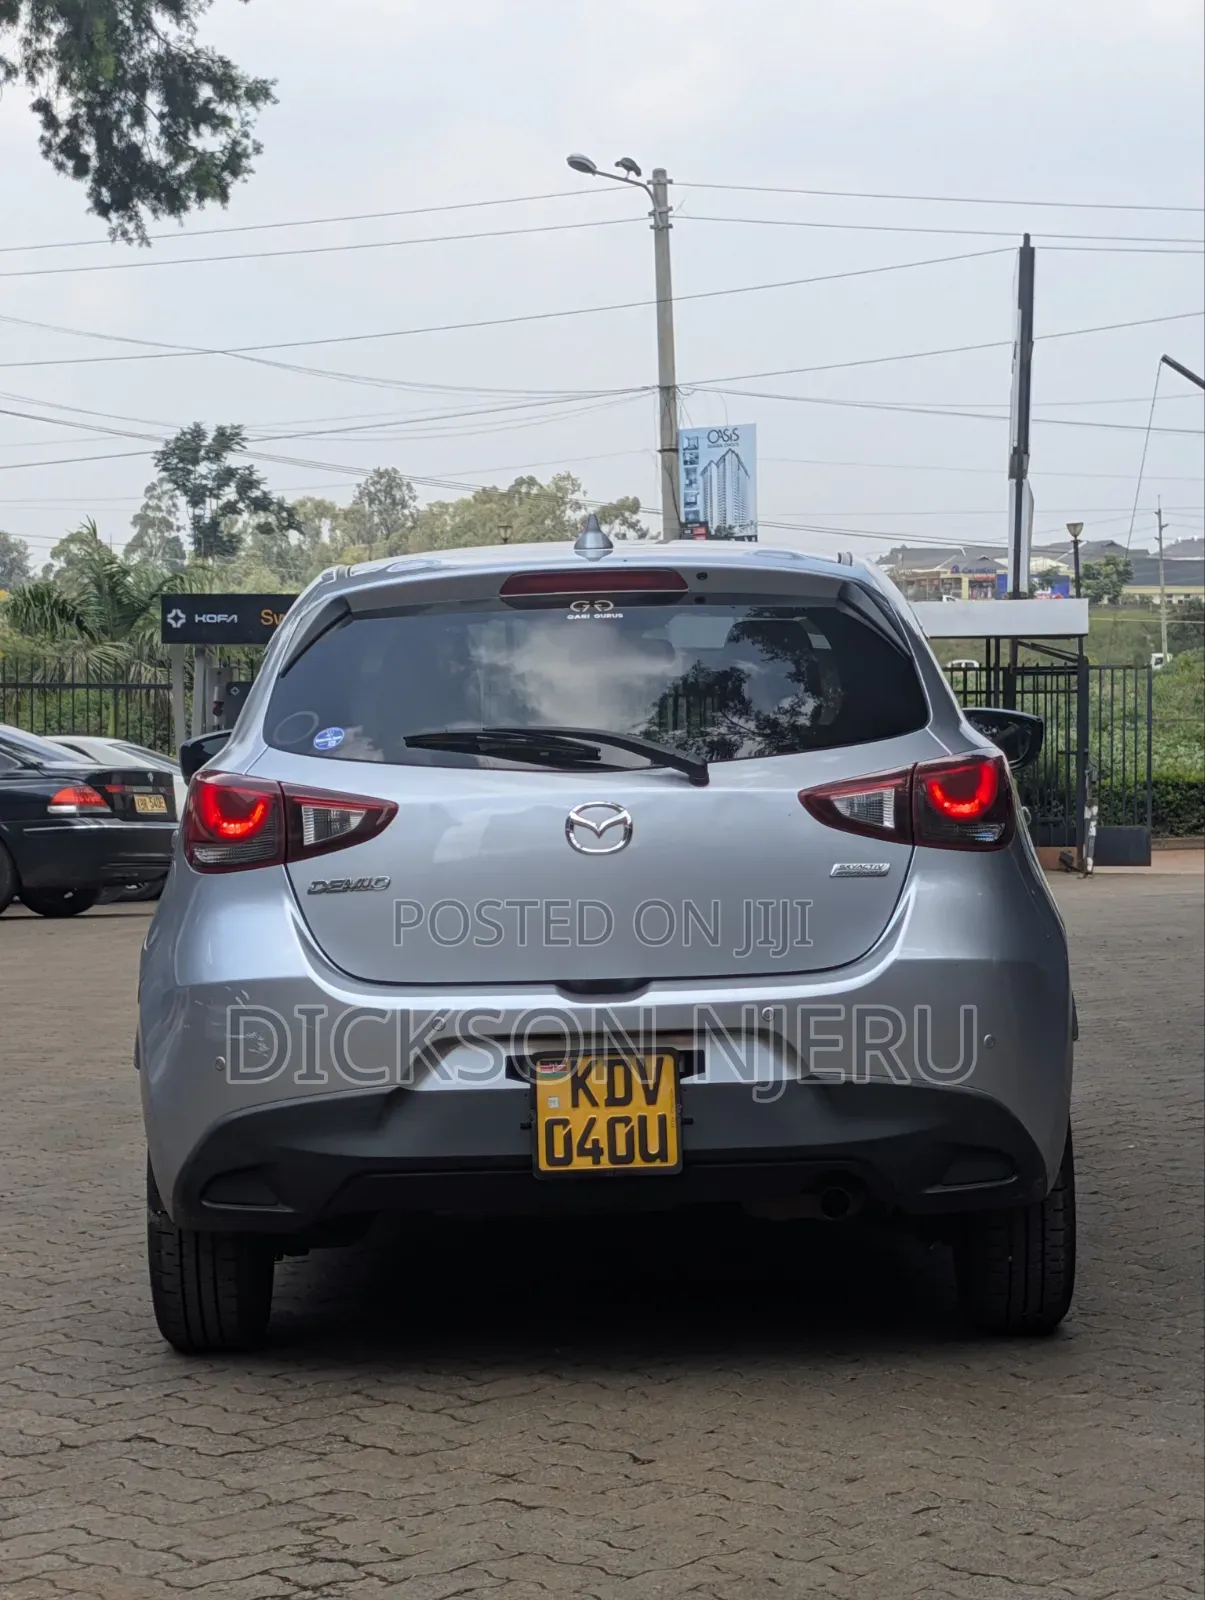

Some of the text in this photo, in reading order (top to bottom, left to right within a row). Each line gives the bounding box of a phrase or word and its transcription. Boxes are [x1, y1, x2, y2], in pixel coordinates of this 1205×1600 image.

[194, 613, 238, 624] KOFA
[307, 875, 391, 895] DEMIO
[570, 1056, 664, 1109] KDV
